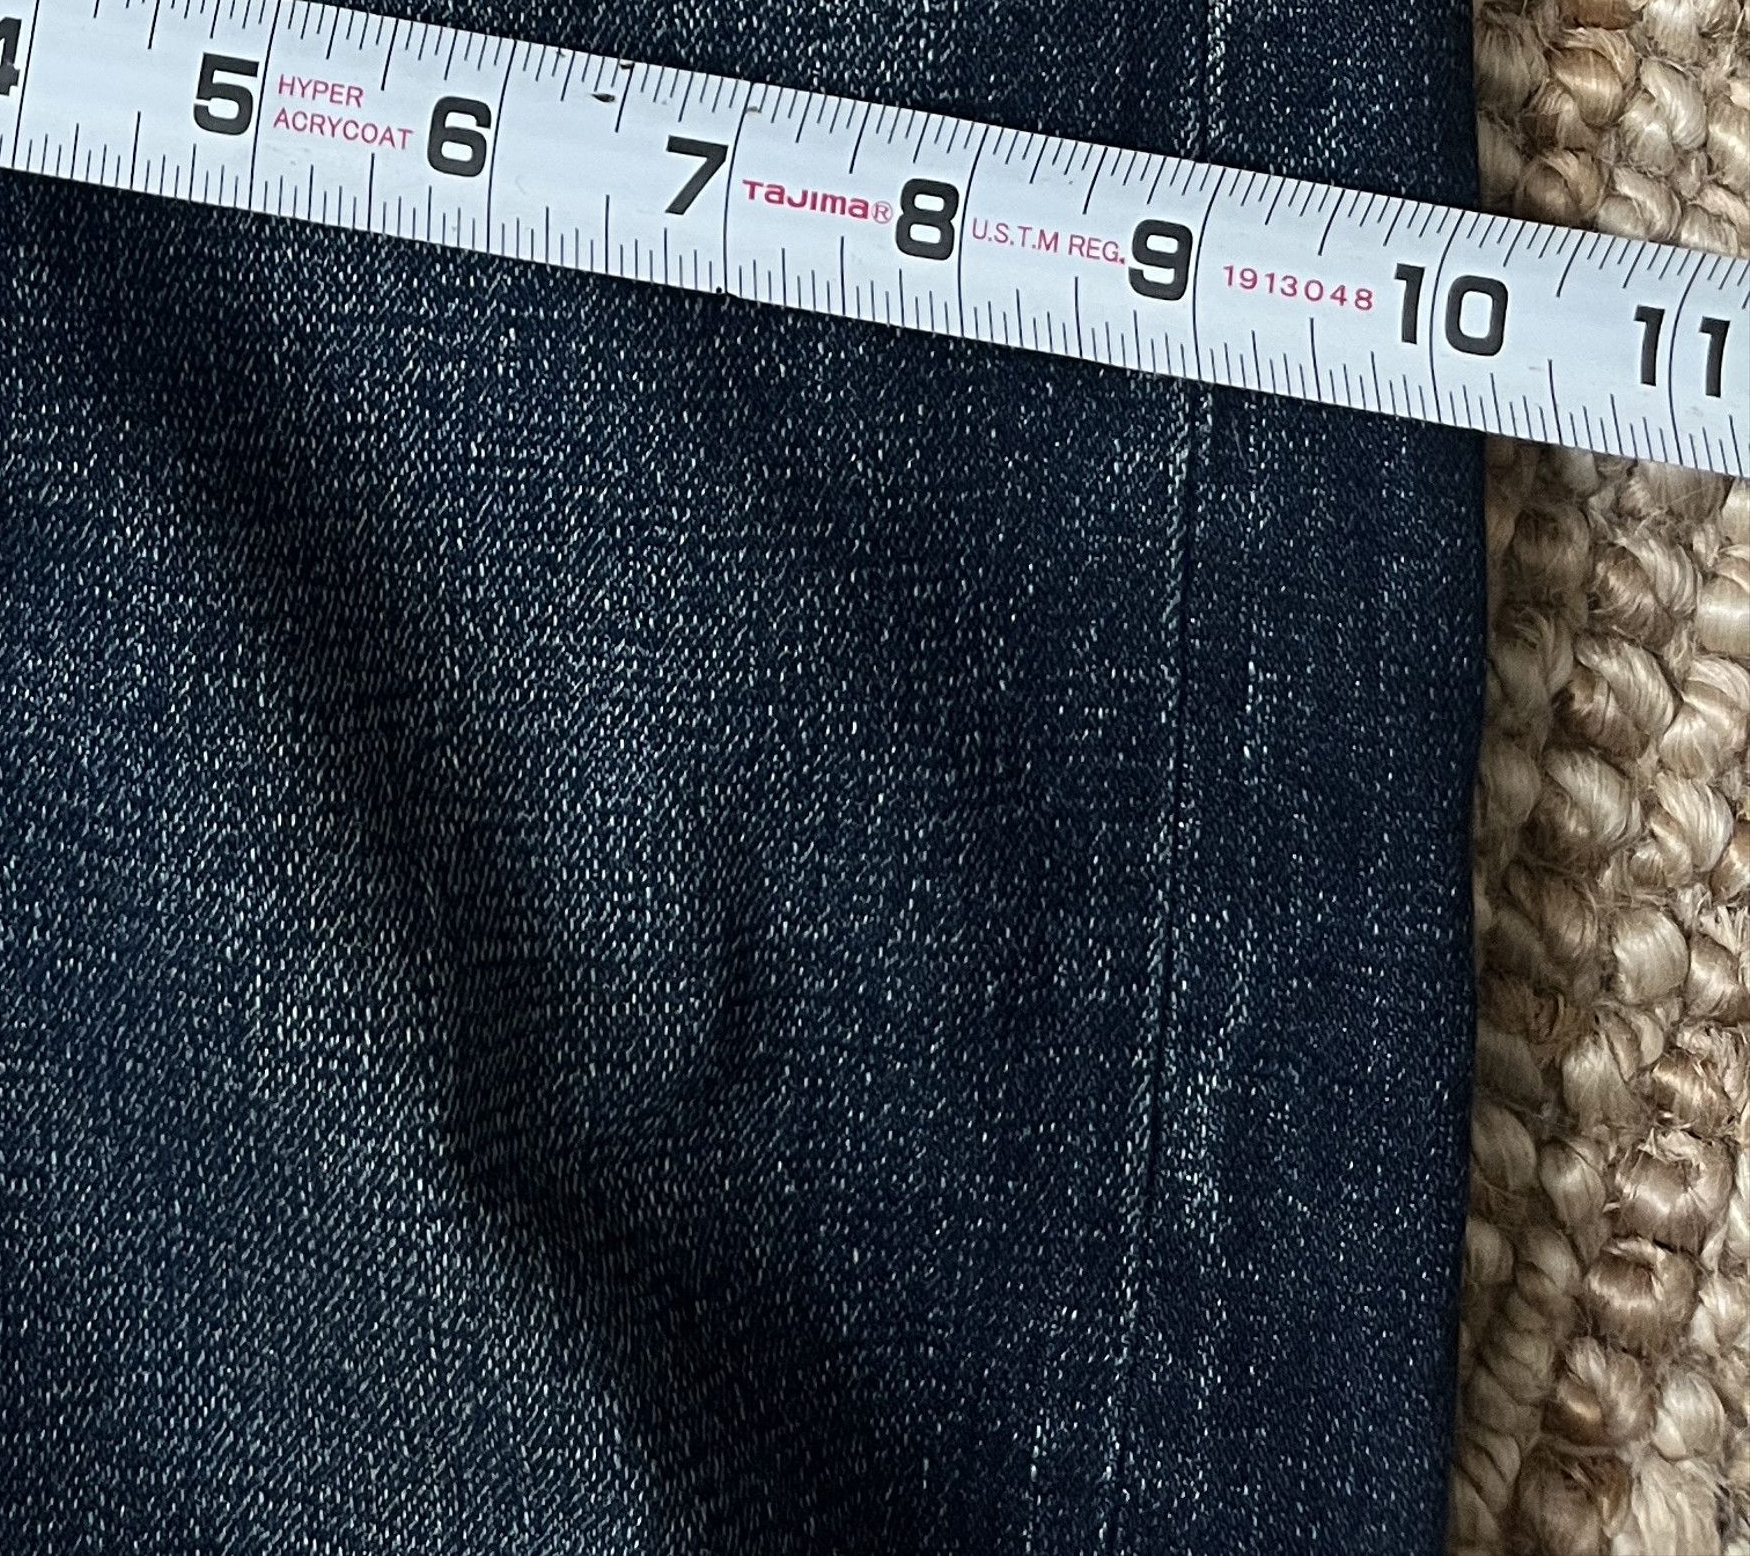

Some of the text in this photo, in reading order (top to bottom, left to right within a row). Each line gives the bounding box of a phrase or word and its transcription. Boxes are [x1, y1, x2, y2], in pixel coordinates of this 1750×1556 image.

[193, 52, 260, 136] 5
[273, 106, 413, 150] ACRYCOAT
[278, 73, 364, 108] HYPER
[427, 96, 492, 178] 6
[665, 135, 729, 216] 7
[895, 178, 960, 261] 8
[972, 217, 1125, 265] U.S.T.M REG.
[1128, 219, 1194, 301] 9
[1223, 265, 1373, 311] 1913048
[1394, 263, 1509, 357] 10
[1634, 305, 1731, 399] 11
